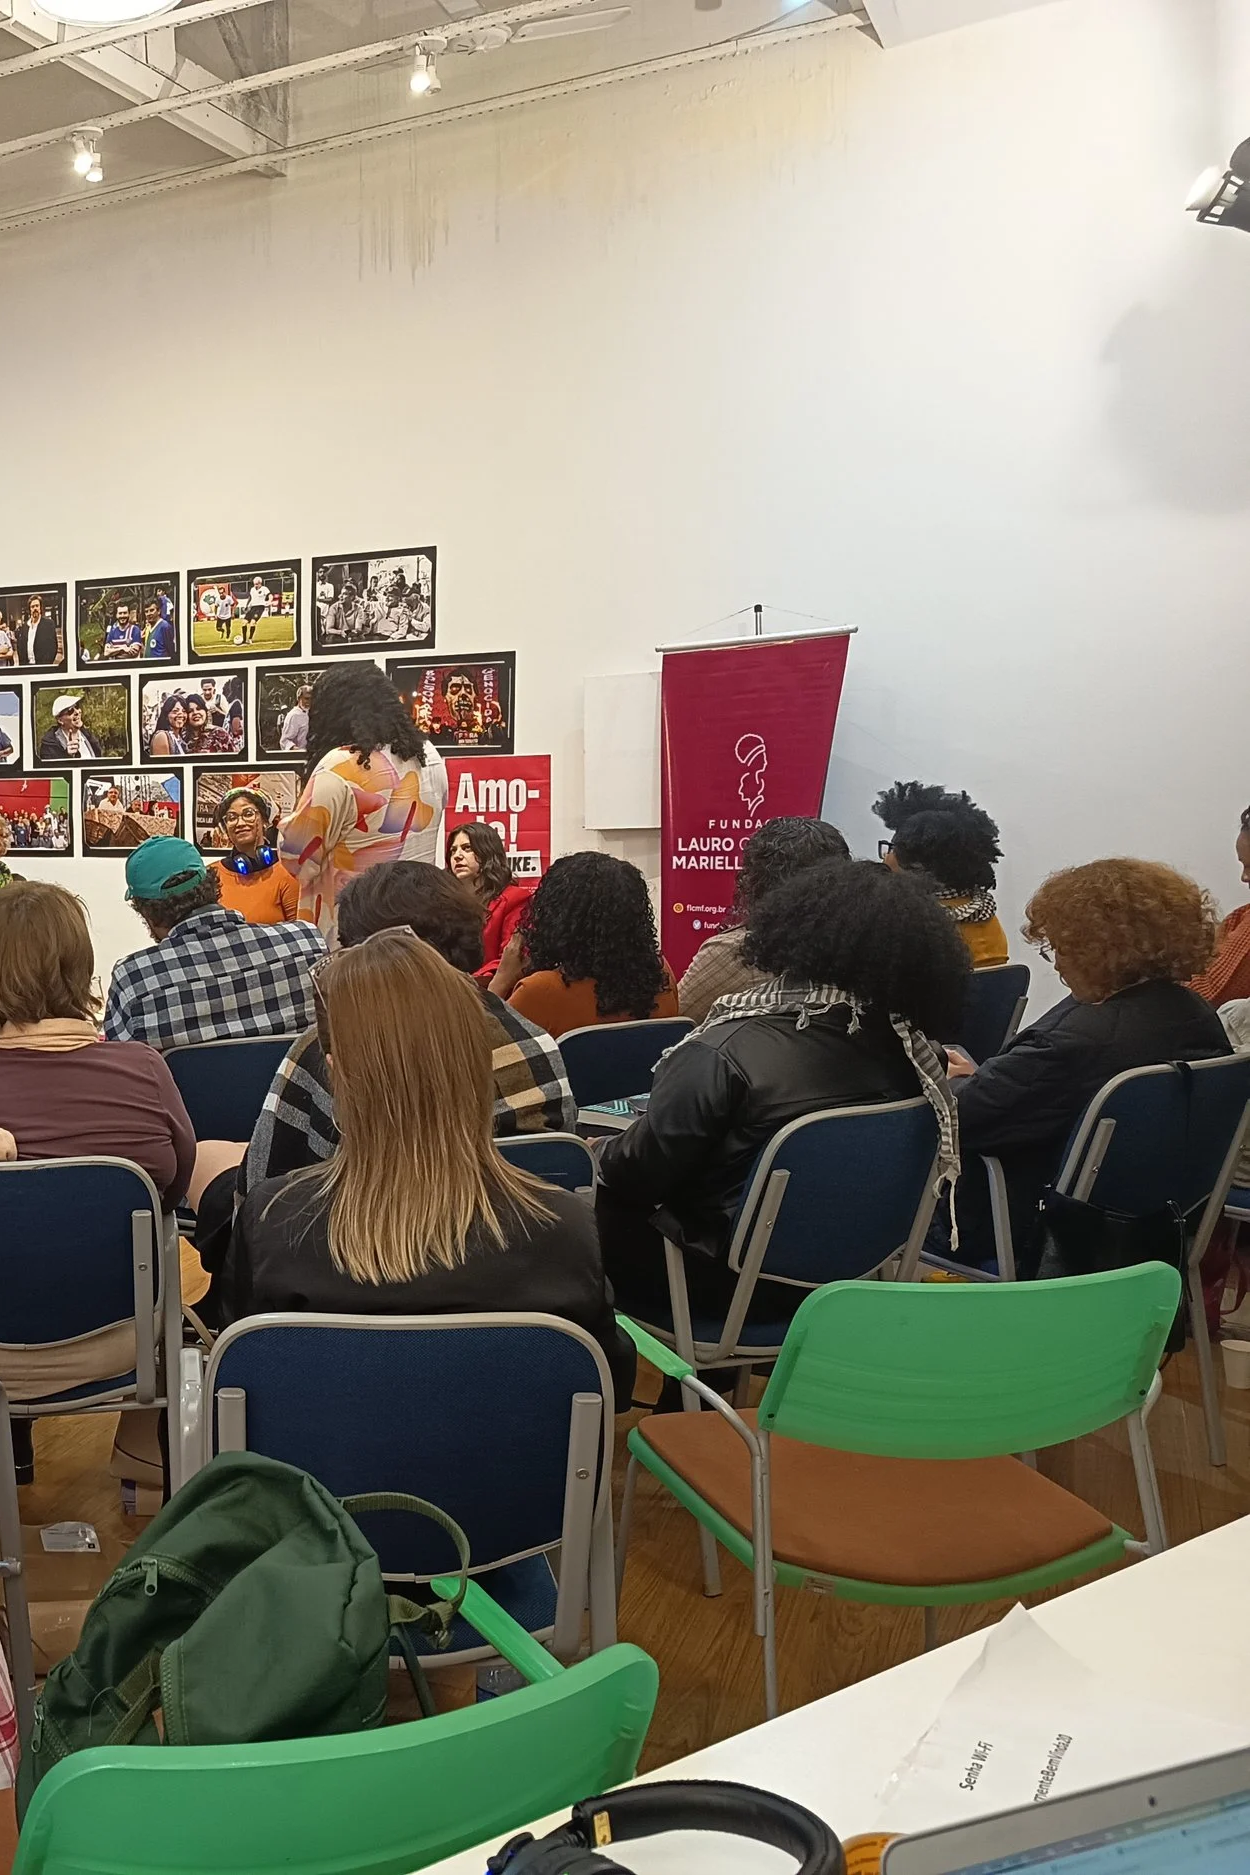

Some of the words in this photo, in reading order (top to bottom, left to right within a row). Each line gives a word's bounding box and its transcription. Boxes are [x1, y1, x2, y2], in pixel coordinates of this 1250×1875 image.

[454, 772, 540, 813] Amo-
[708, 819, 770, 830] FUNDA
[677, 837, 735, 852] LAURO
[507, 856, 537, 872] KE.
[672, 855, 743, 870] MARIELL
[686, 904, 727, 915] flcmf.org.br
[959, 1762, 983, 1791] Senha
[971, 1740, 994, 1762] Wi-Fi
[1033, 1733, 1073, 1802] menteBemVinda20
